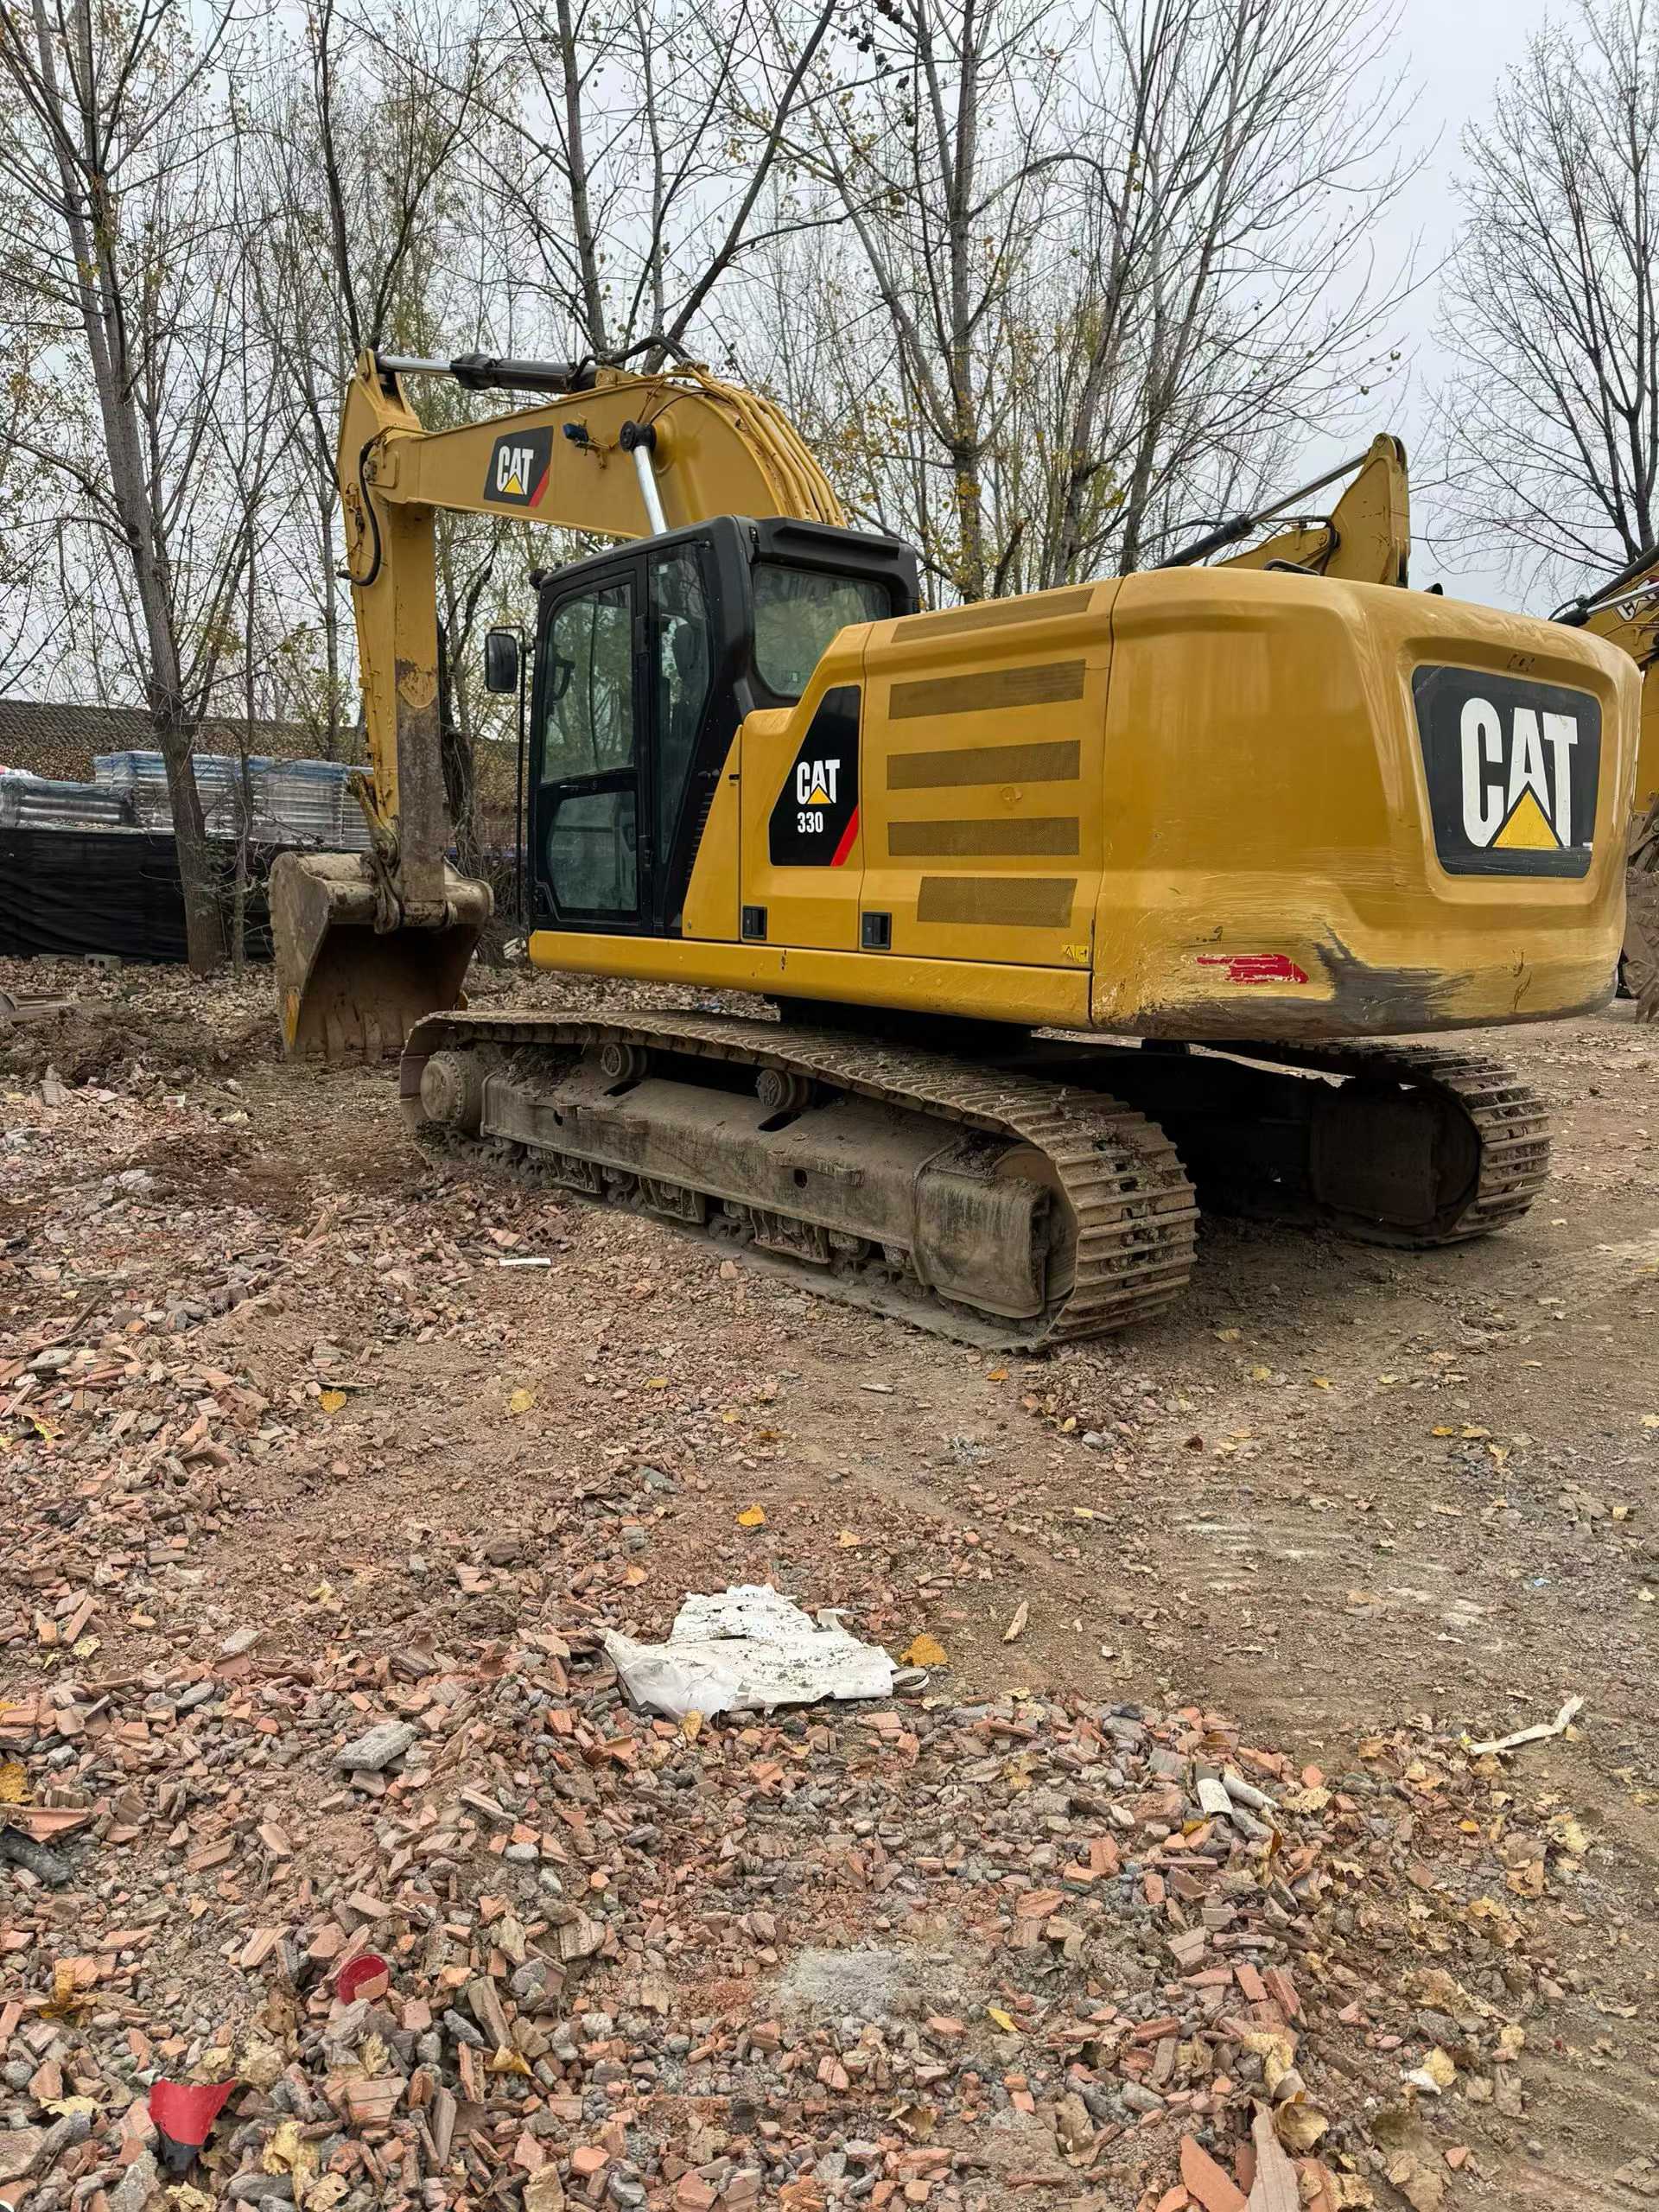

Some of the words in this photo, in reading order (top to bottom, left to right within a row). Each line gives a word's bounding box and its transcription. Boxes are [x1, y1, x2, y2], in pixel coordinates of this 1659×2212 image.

[497, 445, 534, 495] CAT
[797, 760, 841, 804] CAT
[1460, 697, 1579, 849] CAT
[797, 811, 823, 833] 330
